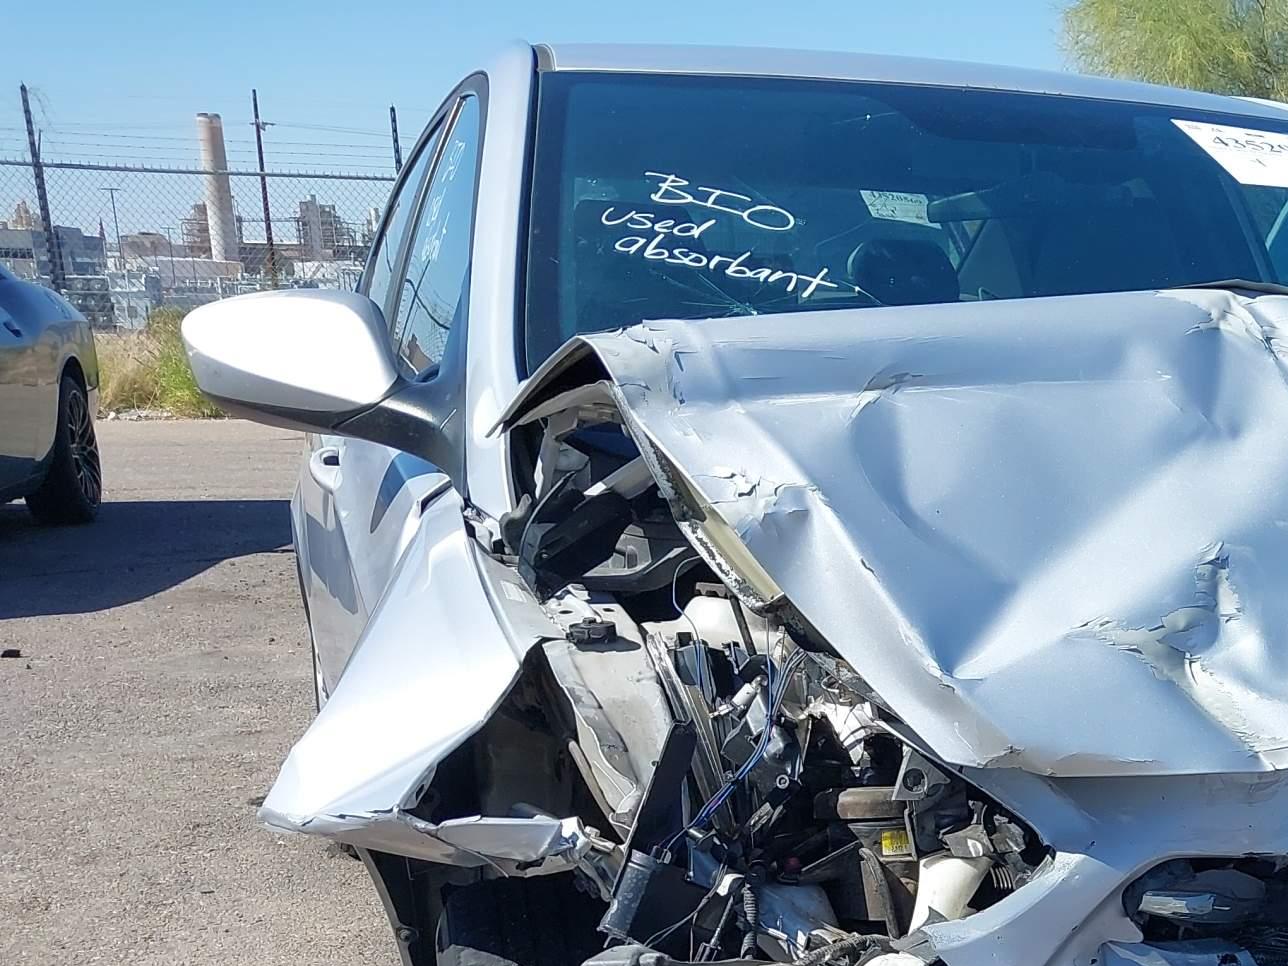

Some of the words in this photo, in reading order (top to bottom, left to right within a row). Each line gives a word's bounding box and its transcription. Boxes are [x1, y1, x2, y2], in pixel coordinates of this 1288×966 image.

[601, 207, 716, 239] used
[645, 171, 795, 231] BIO
[614, 233, 838, 298] absorbant
